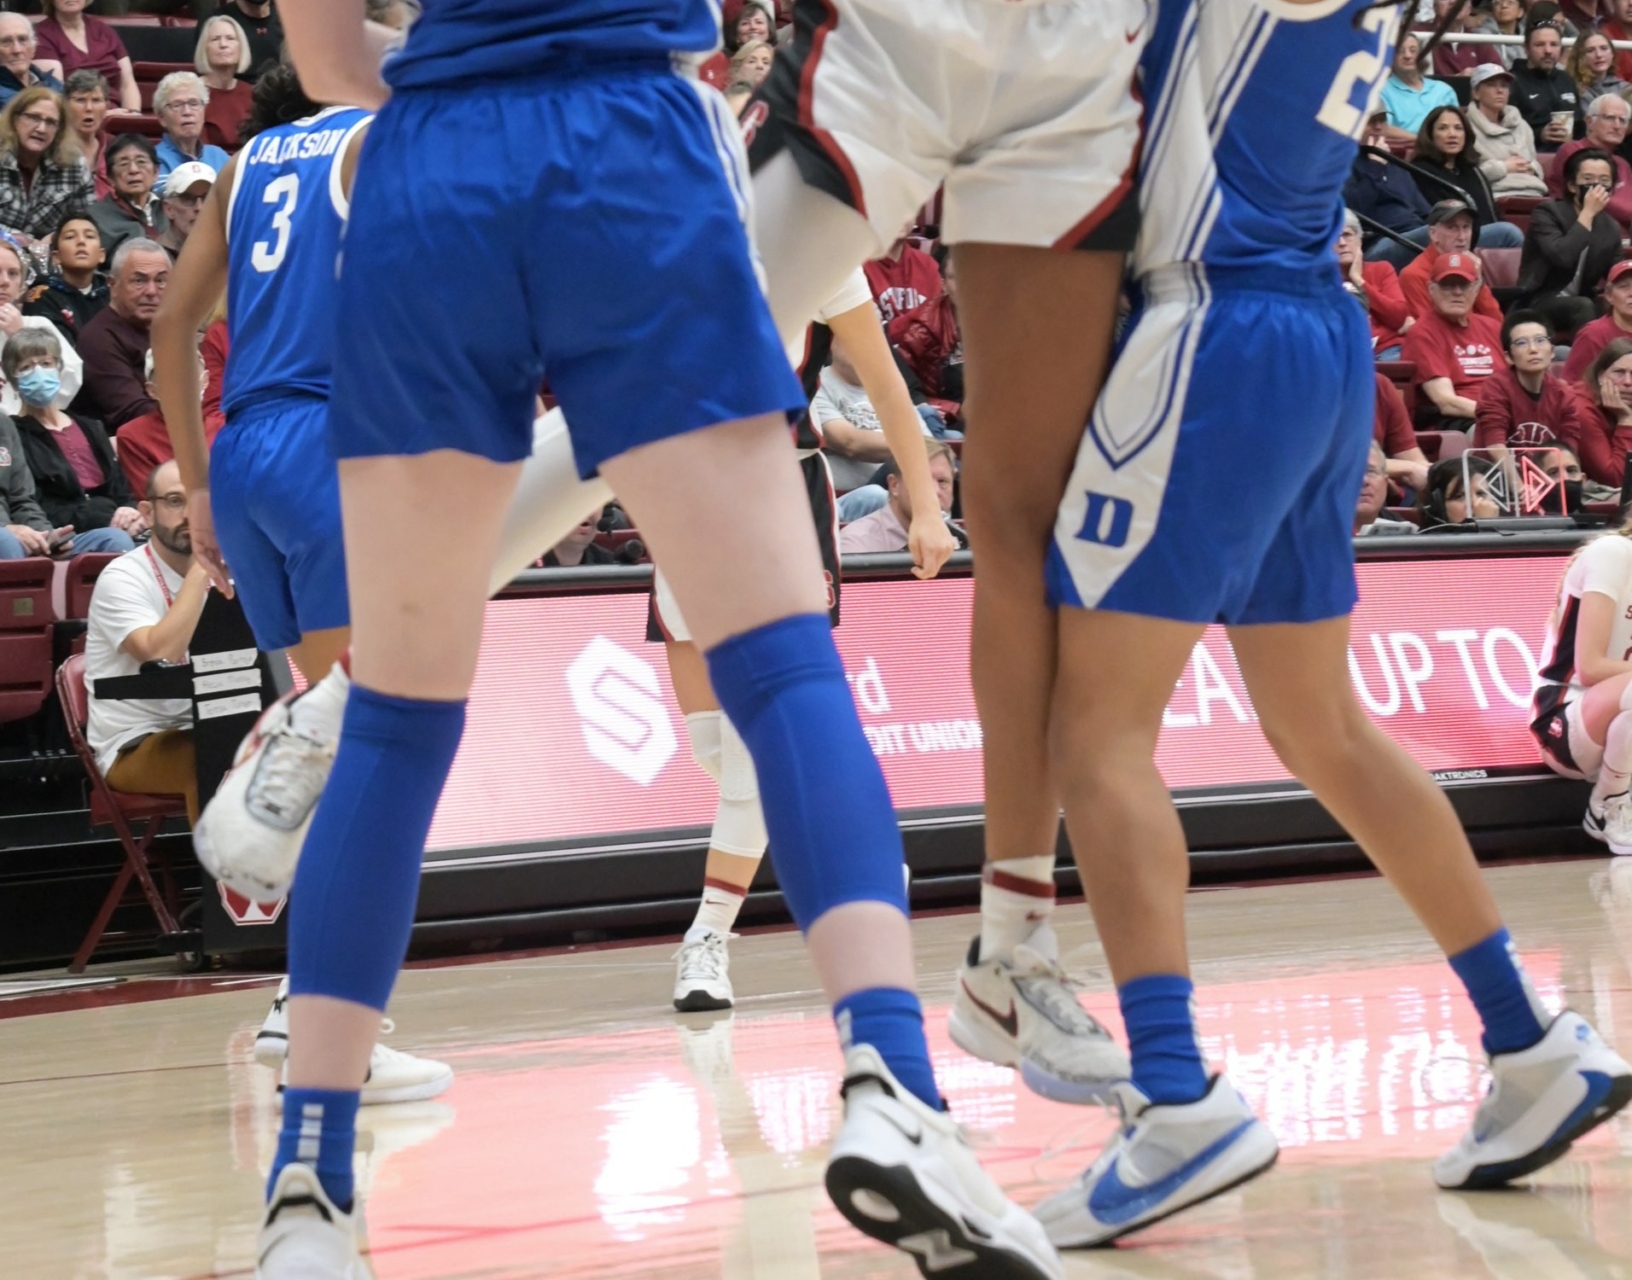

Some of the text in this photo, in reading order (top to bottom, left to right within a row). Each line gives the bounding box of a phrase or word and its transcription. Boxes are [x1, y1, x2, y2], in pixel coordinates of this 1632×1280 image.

[250, 128, 347, 165] JACKSON
[251, 173, 299, 273] 3
[1347, 631, 1435, 716] UP
[1435, 626, 1541, 710] TO
